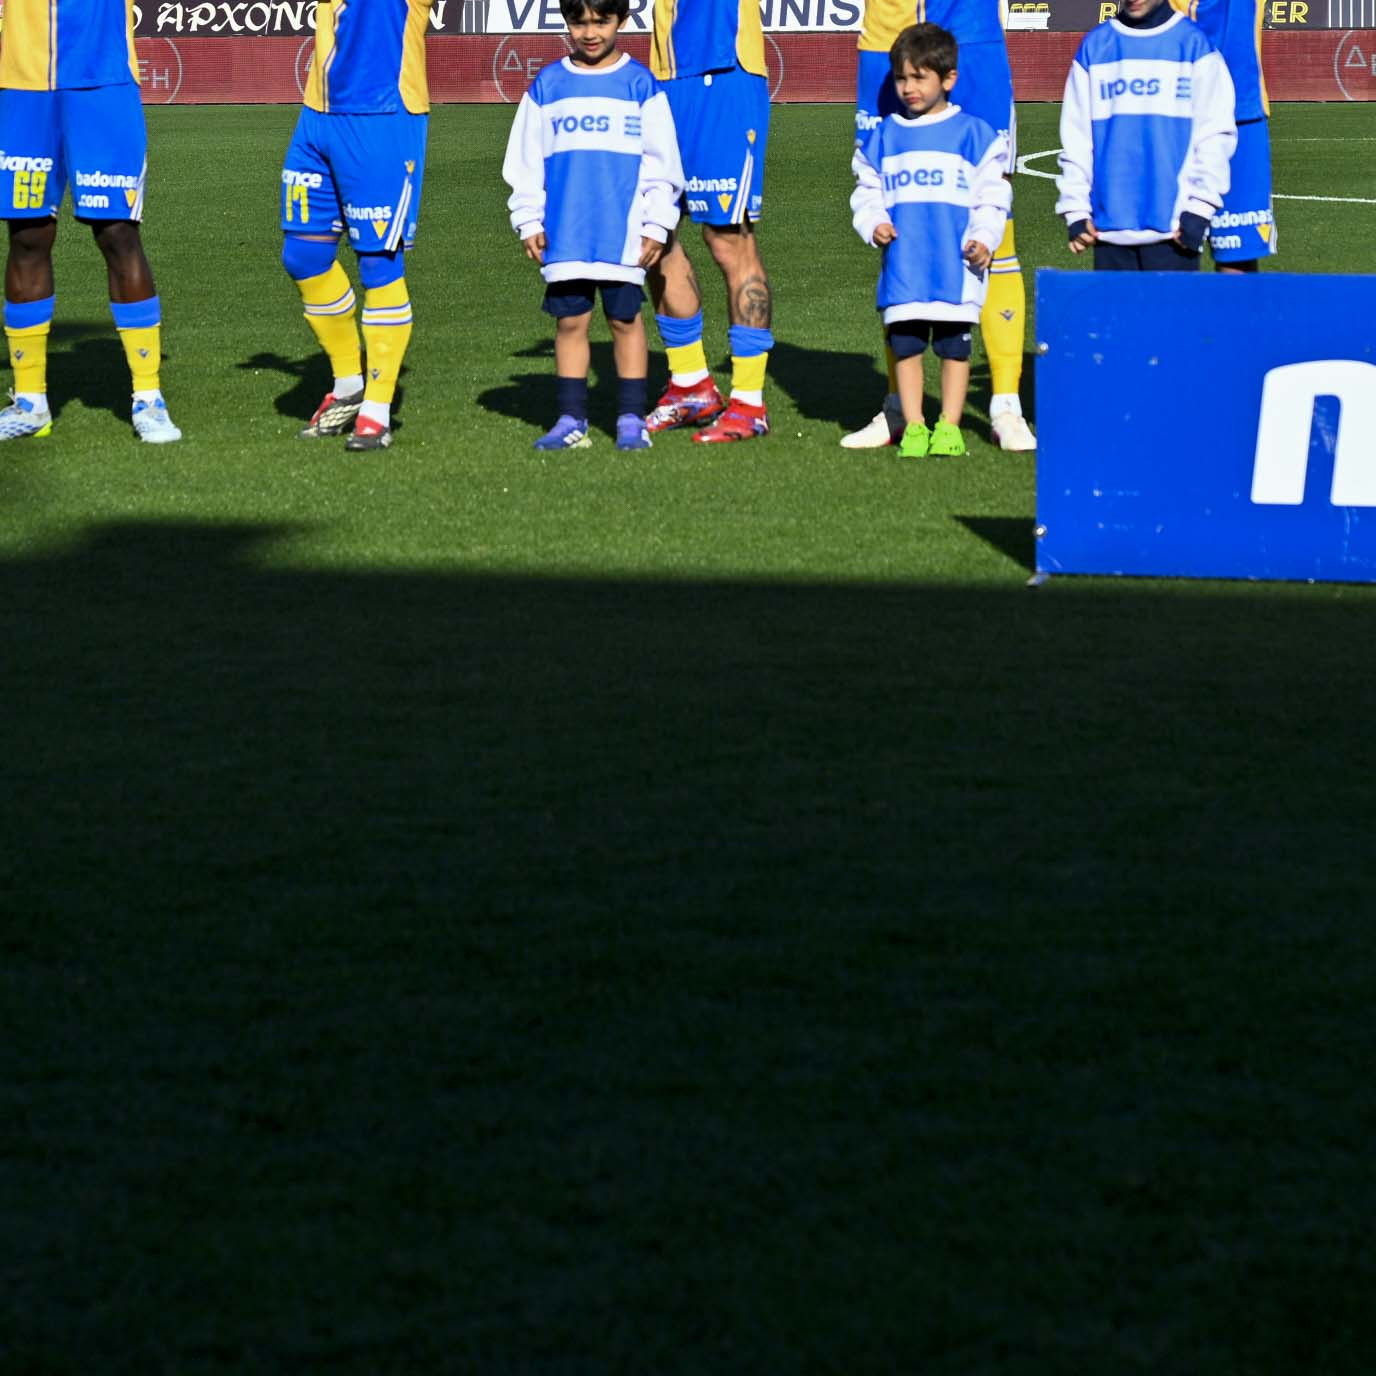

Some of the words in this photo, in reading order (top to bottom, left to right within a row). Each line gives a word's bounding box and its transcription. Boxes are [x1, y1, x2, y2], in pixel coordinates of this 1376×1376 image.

[138, 59, 170, 90] ΕΗ
[503, 49, 542, 80] ΔΕ
[12, 170, 48, 209] 69
[281, 168, 323, 189] ance
